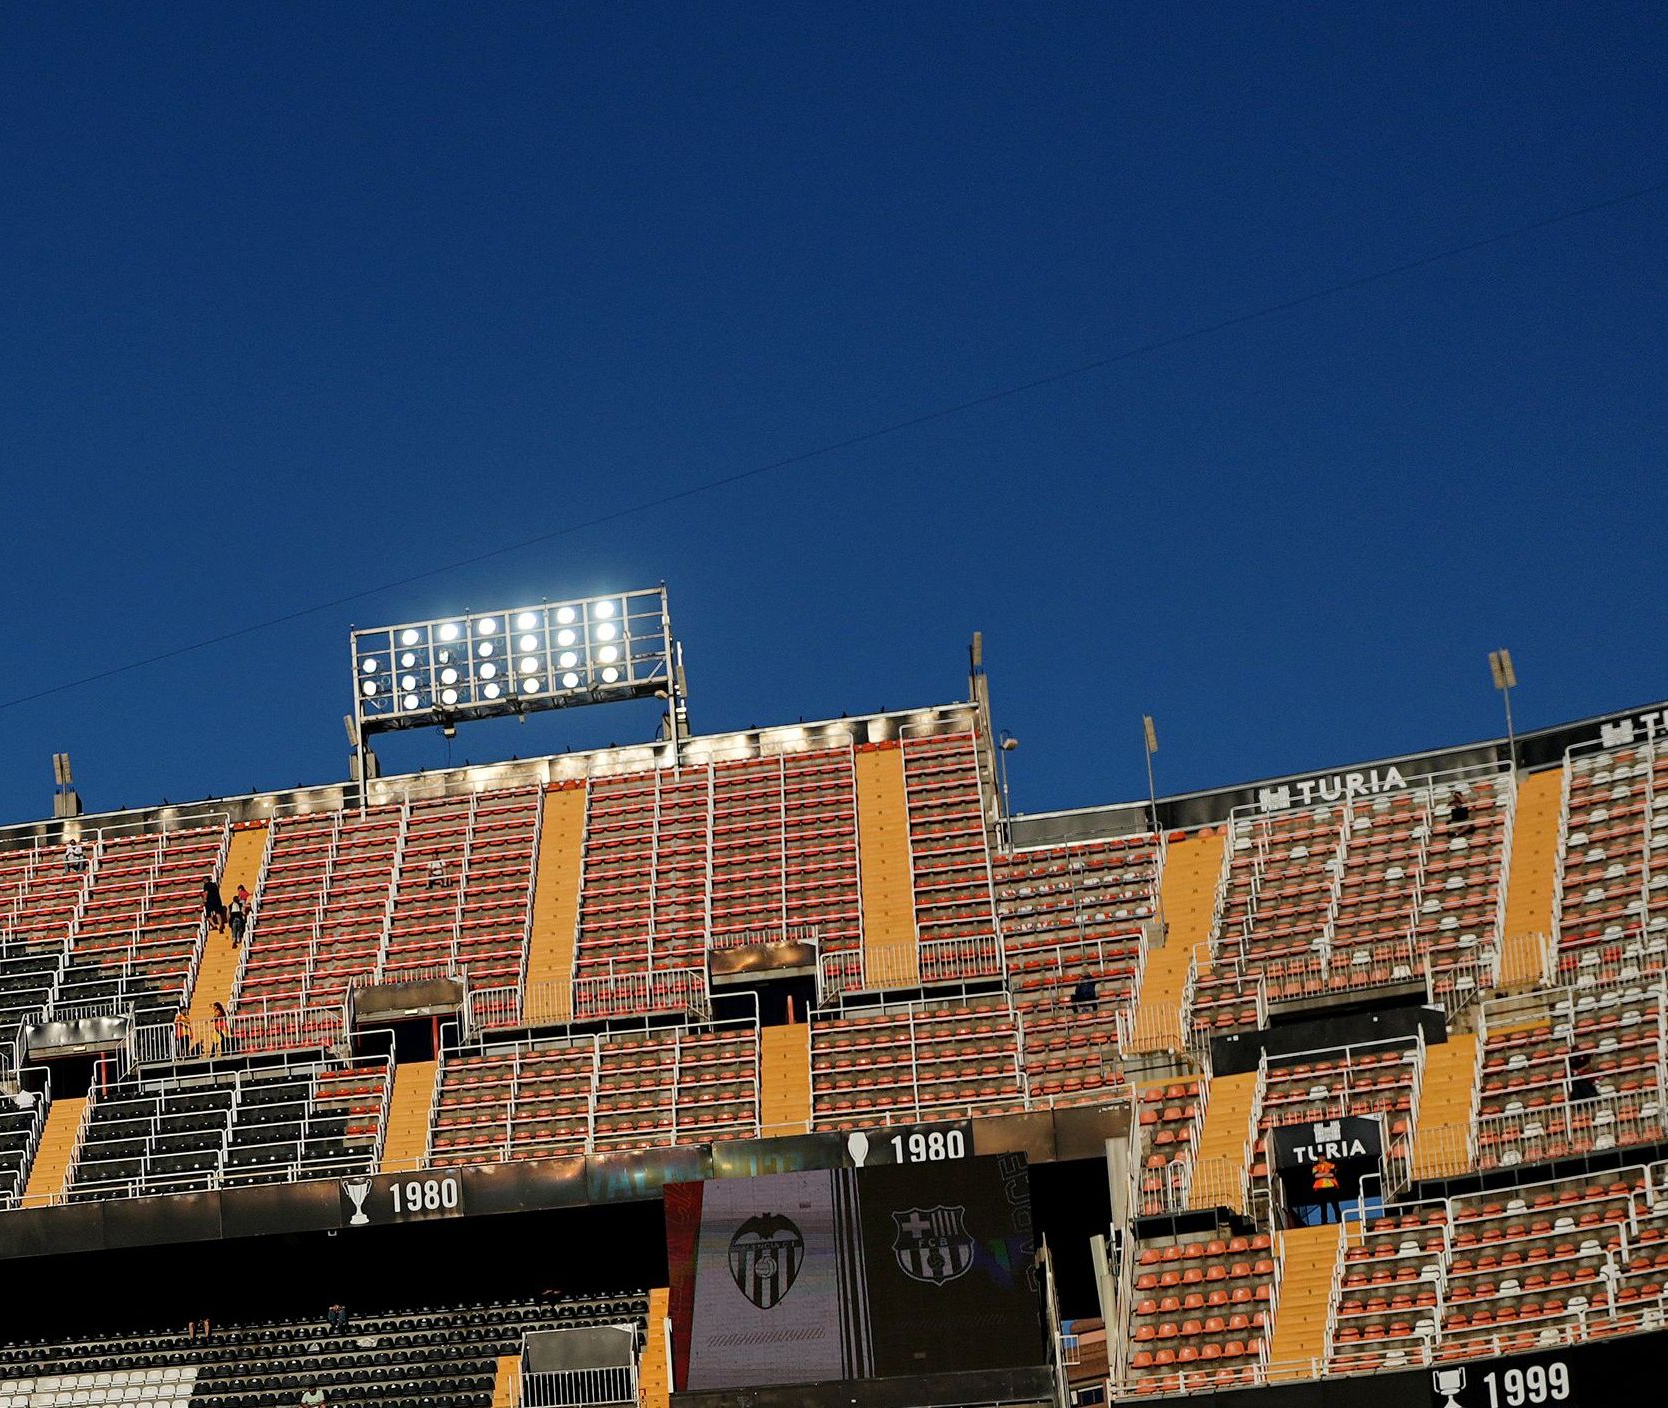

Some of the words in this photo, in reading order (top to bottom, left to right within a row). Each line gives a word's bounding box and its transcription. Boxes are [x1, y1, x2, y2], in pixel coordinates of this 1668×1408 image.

[1297, 766, 1407, 804] TURIA
[891, 1130, 965, 1164] 1980
[1293, 1139, 1366, 1163] TURIA
[390, 1178, 458, 1215] 1980
[1484, 1363, 1569, 1408] 1999
